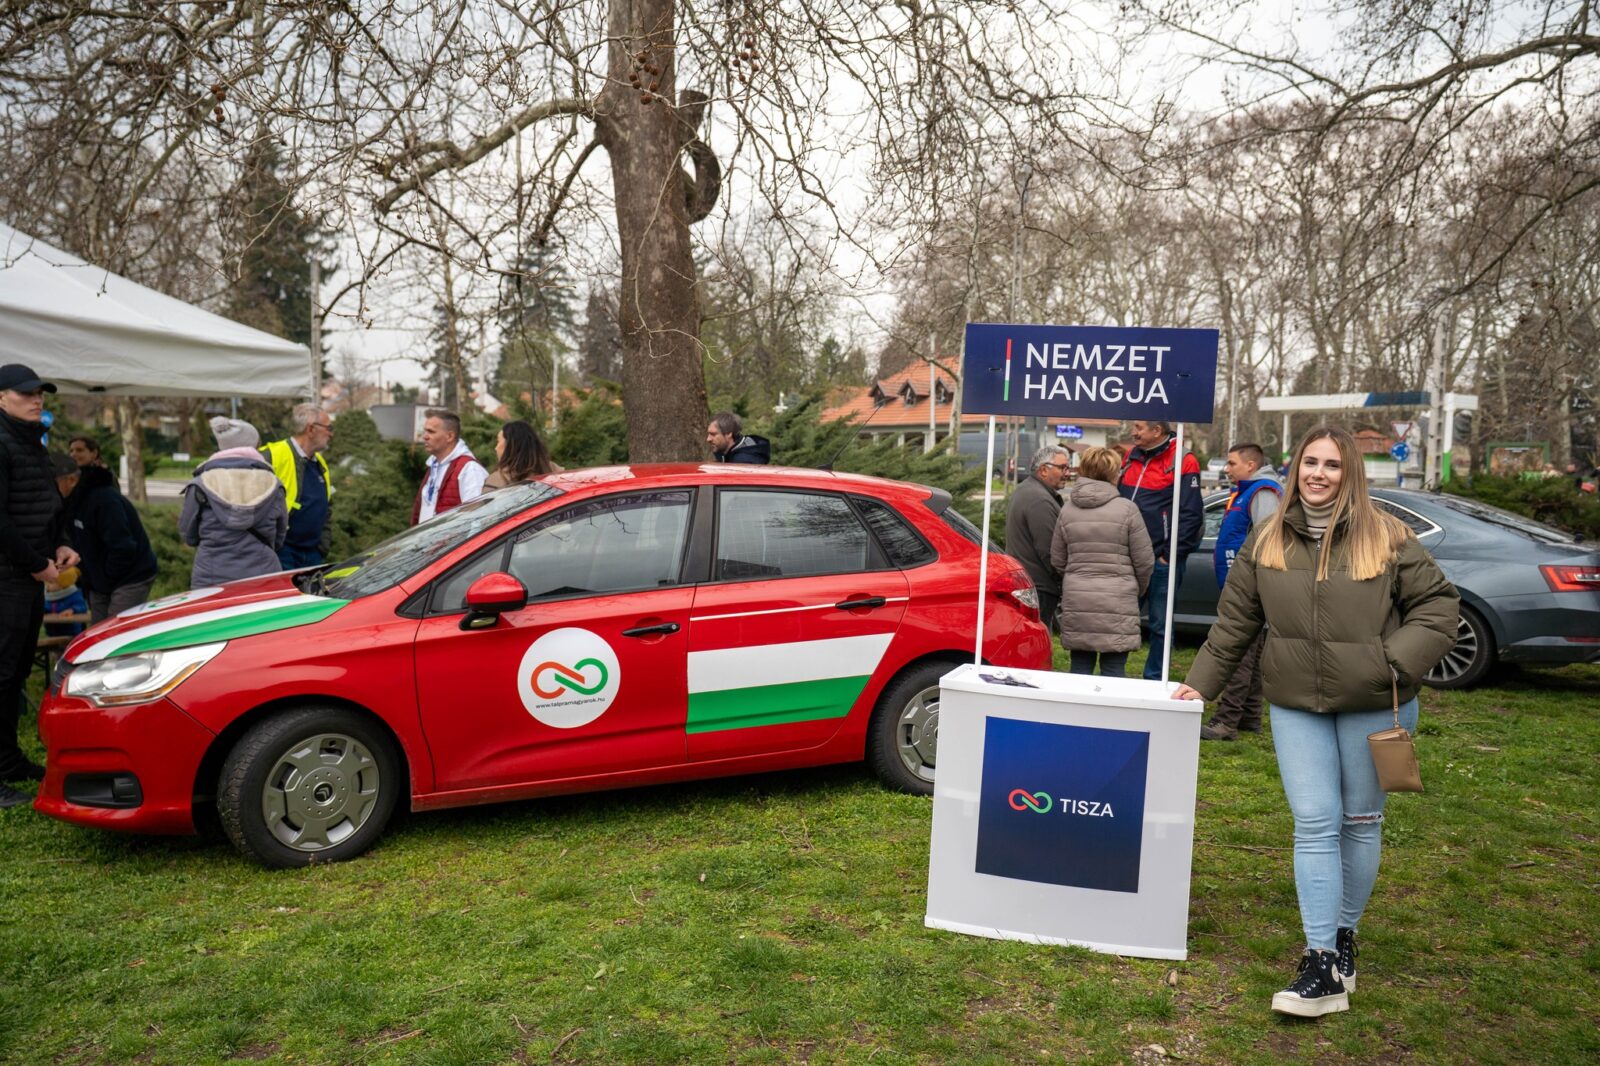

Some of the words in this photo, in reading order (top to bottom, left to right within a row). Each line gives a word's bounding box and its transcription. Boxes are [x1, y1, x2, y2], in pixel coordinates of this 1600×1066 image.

[1025, 342, 1171, 373] NEMZET
[1023, 373, 1169, 405] HANGJA
[1059, 798, 1114, 818] TISZA
